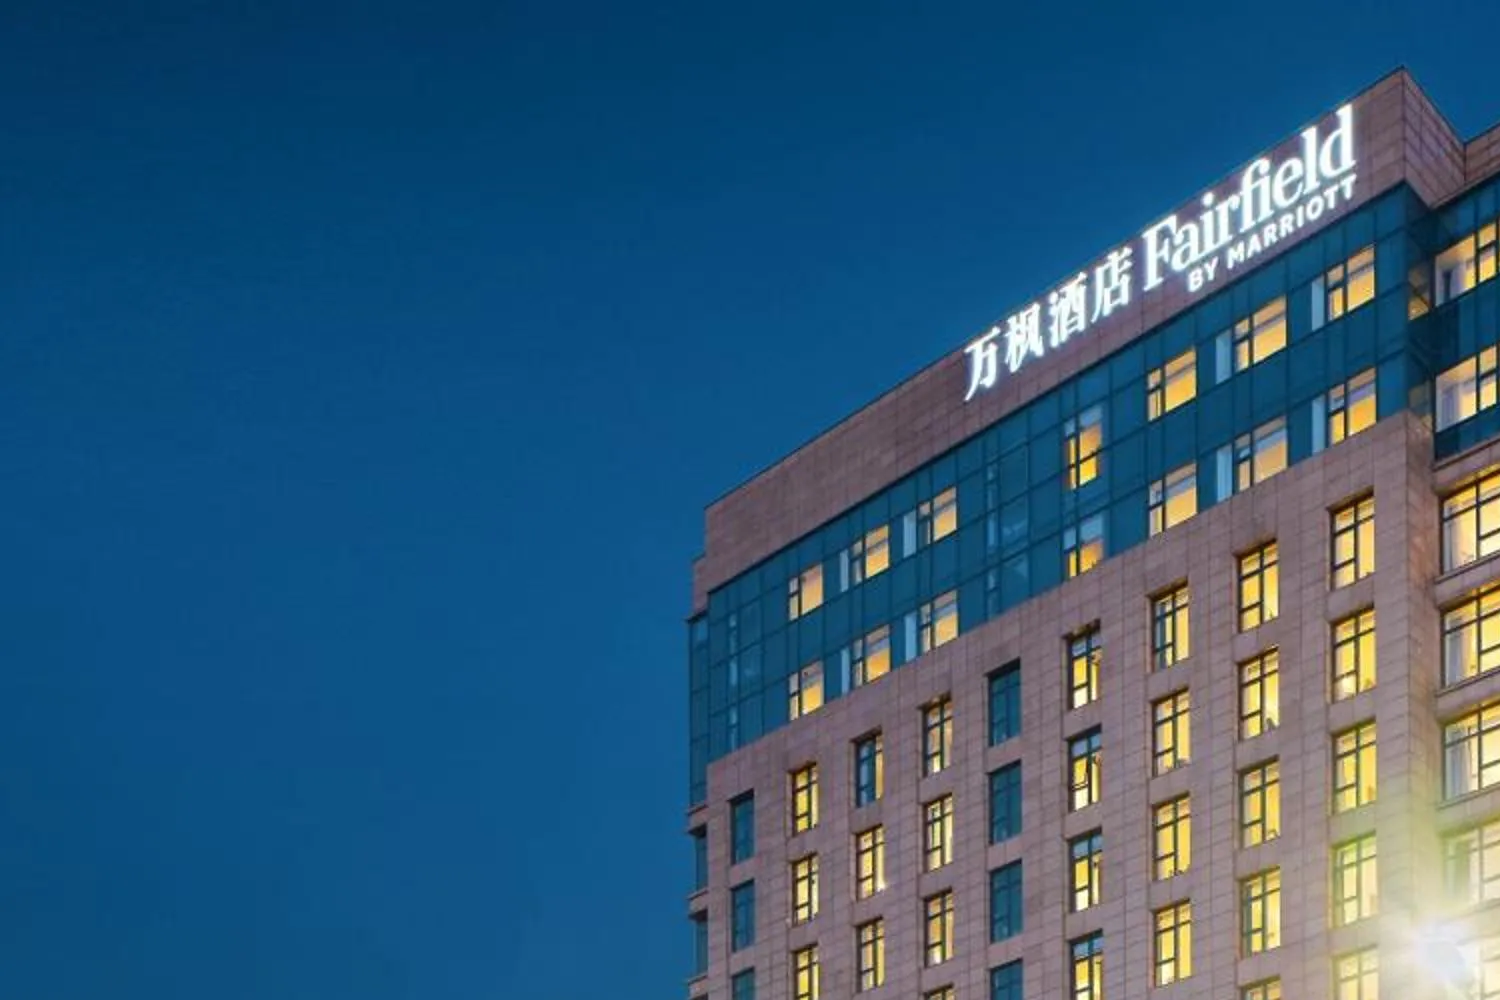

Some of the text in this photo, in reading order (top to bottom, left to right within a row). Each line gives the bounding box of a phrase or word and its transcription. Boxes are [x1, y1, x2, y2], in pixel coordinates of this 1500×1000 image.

[965, 103, 1356, 401] 万枫酒店 Fairfield
[1187, 173, 1357, 293] BY MARRIOTT
